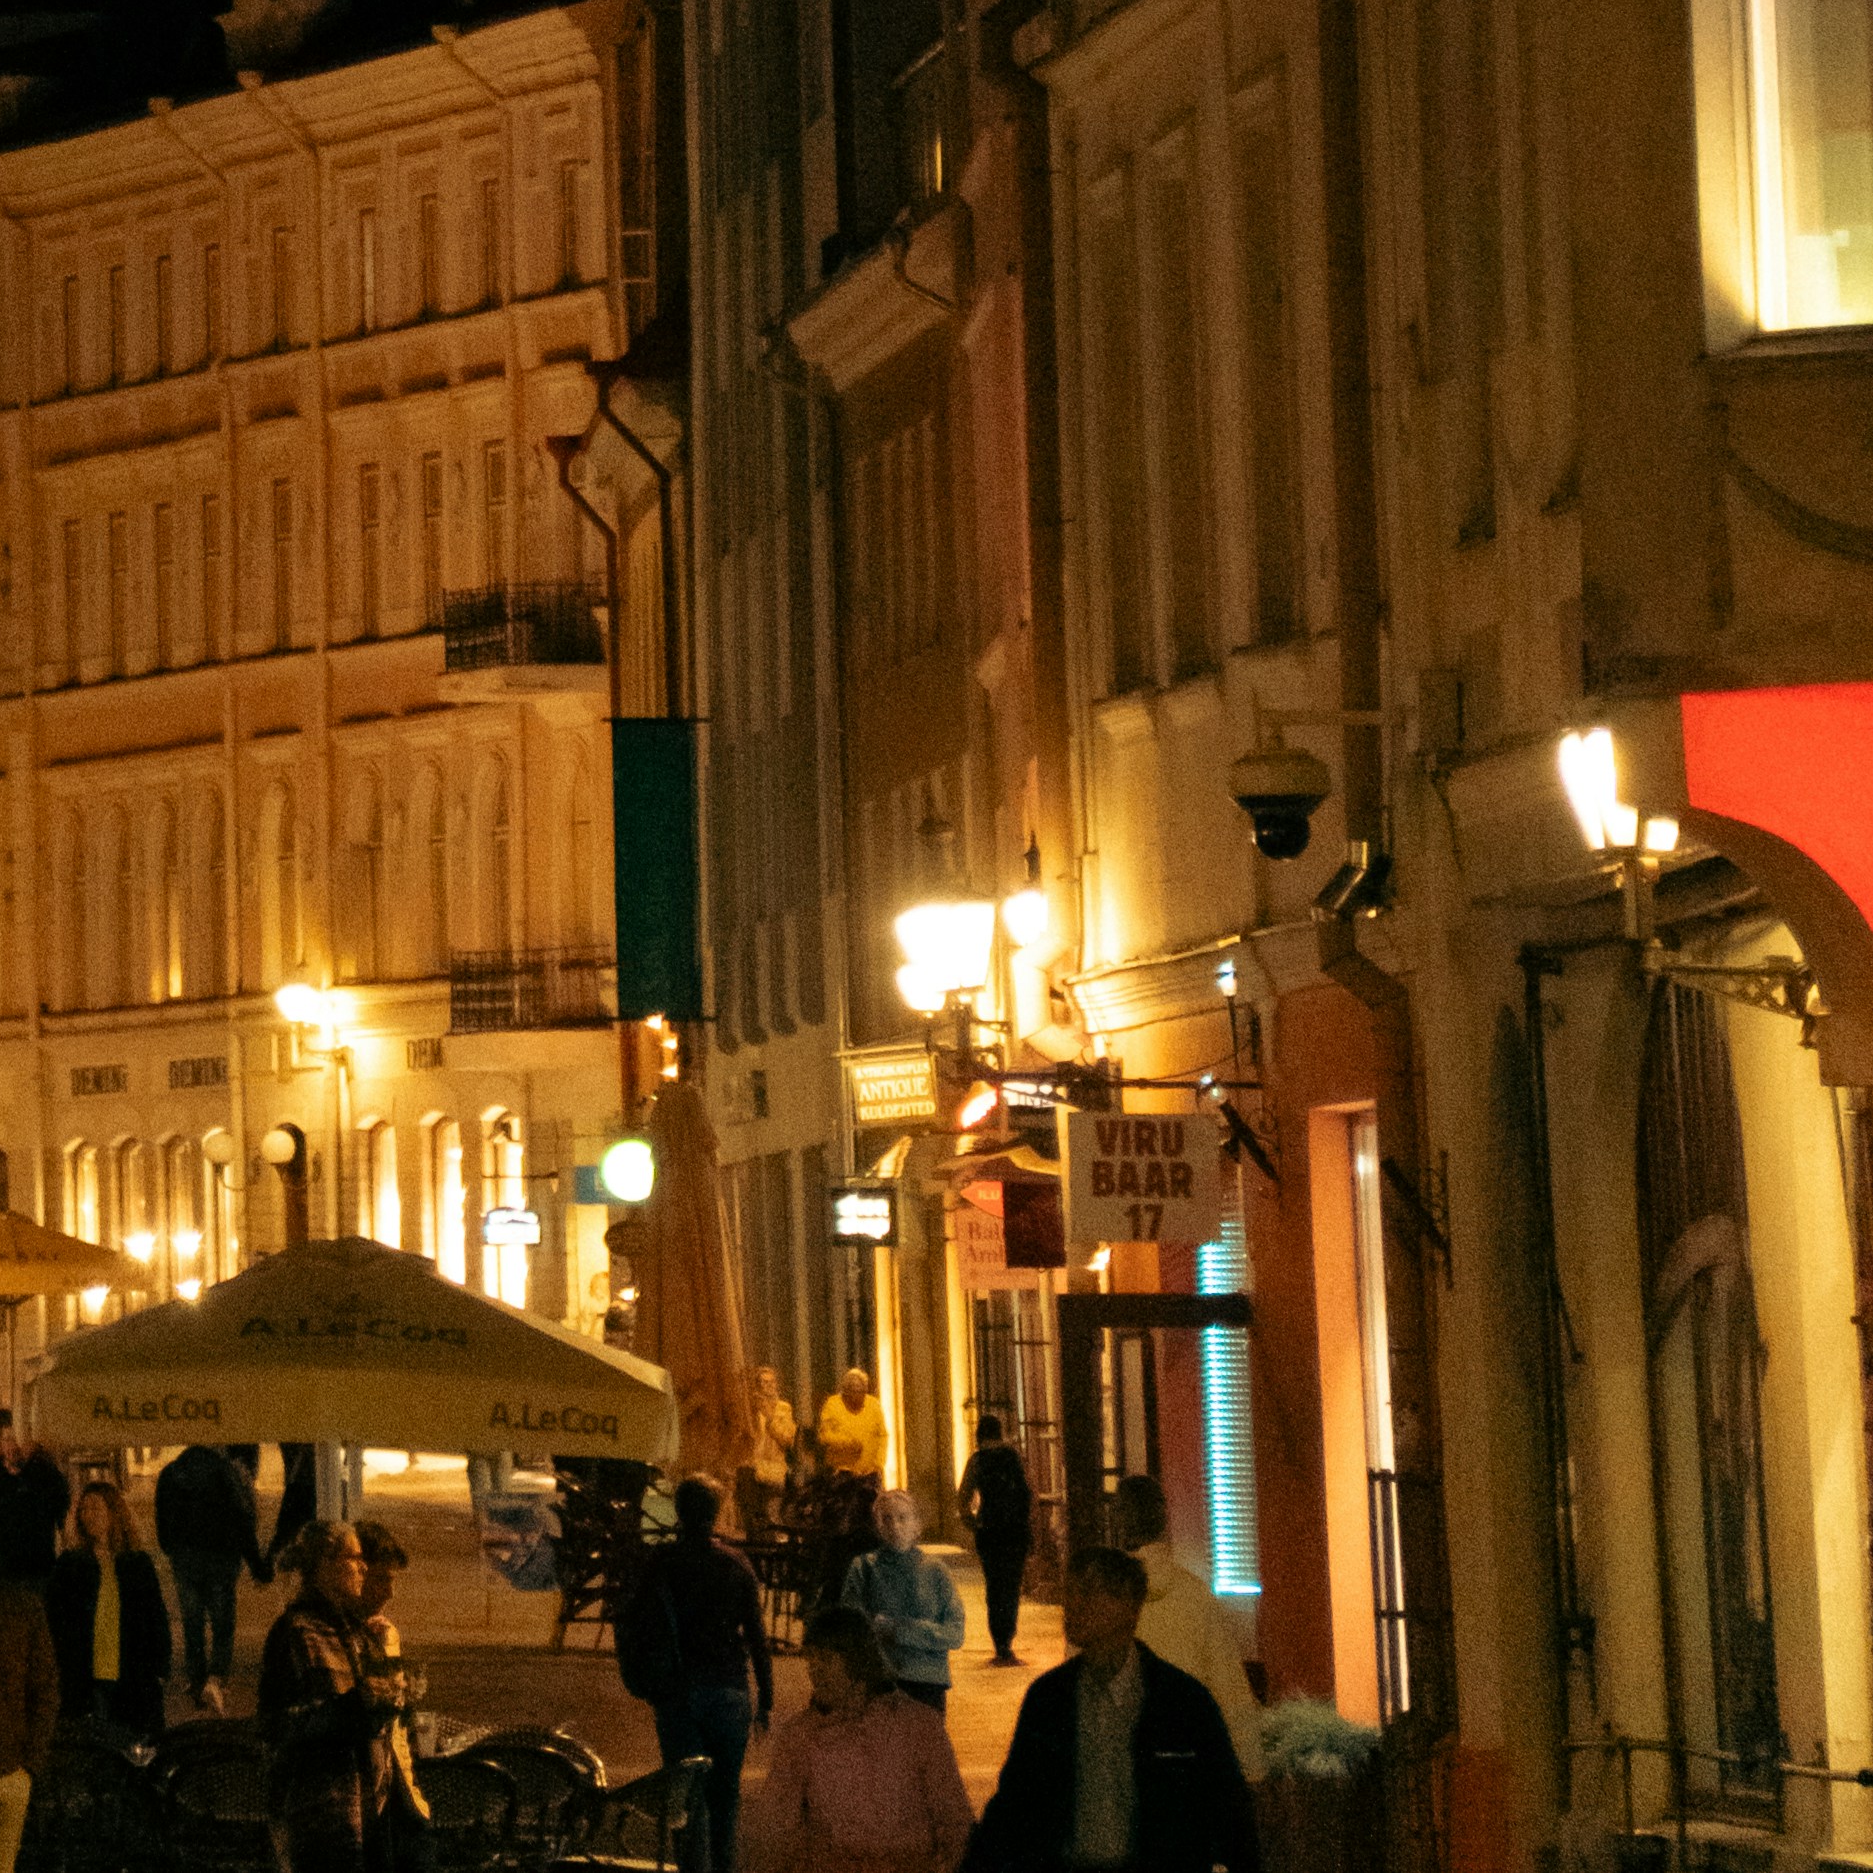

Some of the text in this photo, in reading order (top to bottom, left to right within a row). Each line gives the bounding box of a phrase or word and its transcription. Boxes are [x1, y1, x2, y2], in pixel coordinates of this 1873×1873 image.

[859, 1077, 929, 1102] ANTIQUE
[1095, 1119, 1185, 1157] VIRU
[1091, 1160, 1194, 1199] BAAR
[1124, 1204, 1165, 1241] 17
